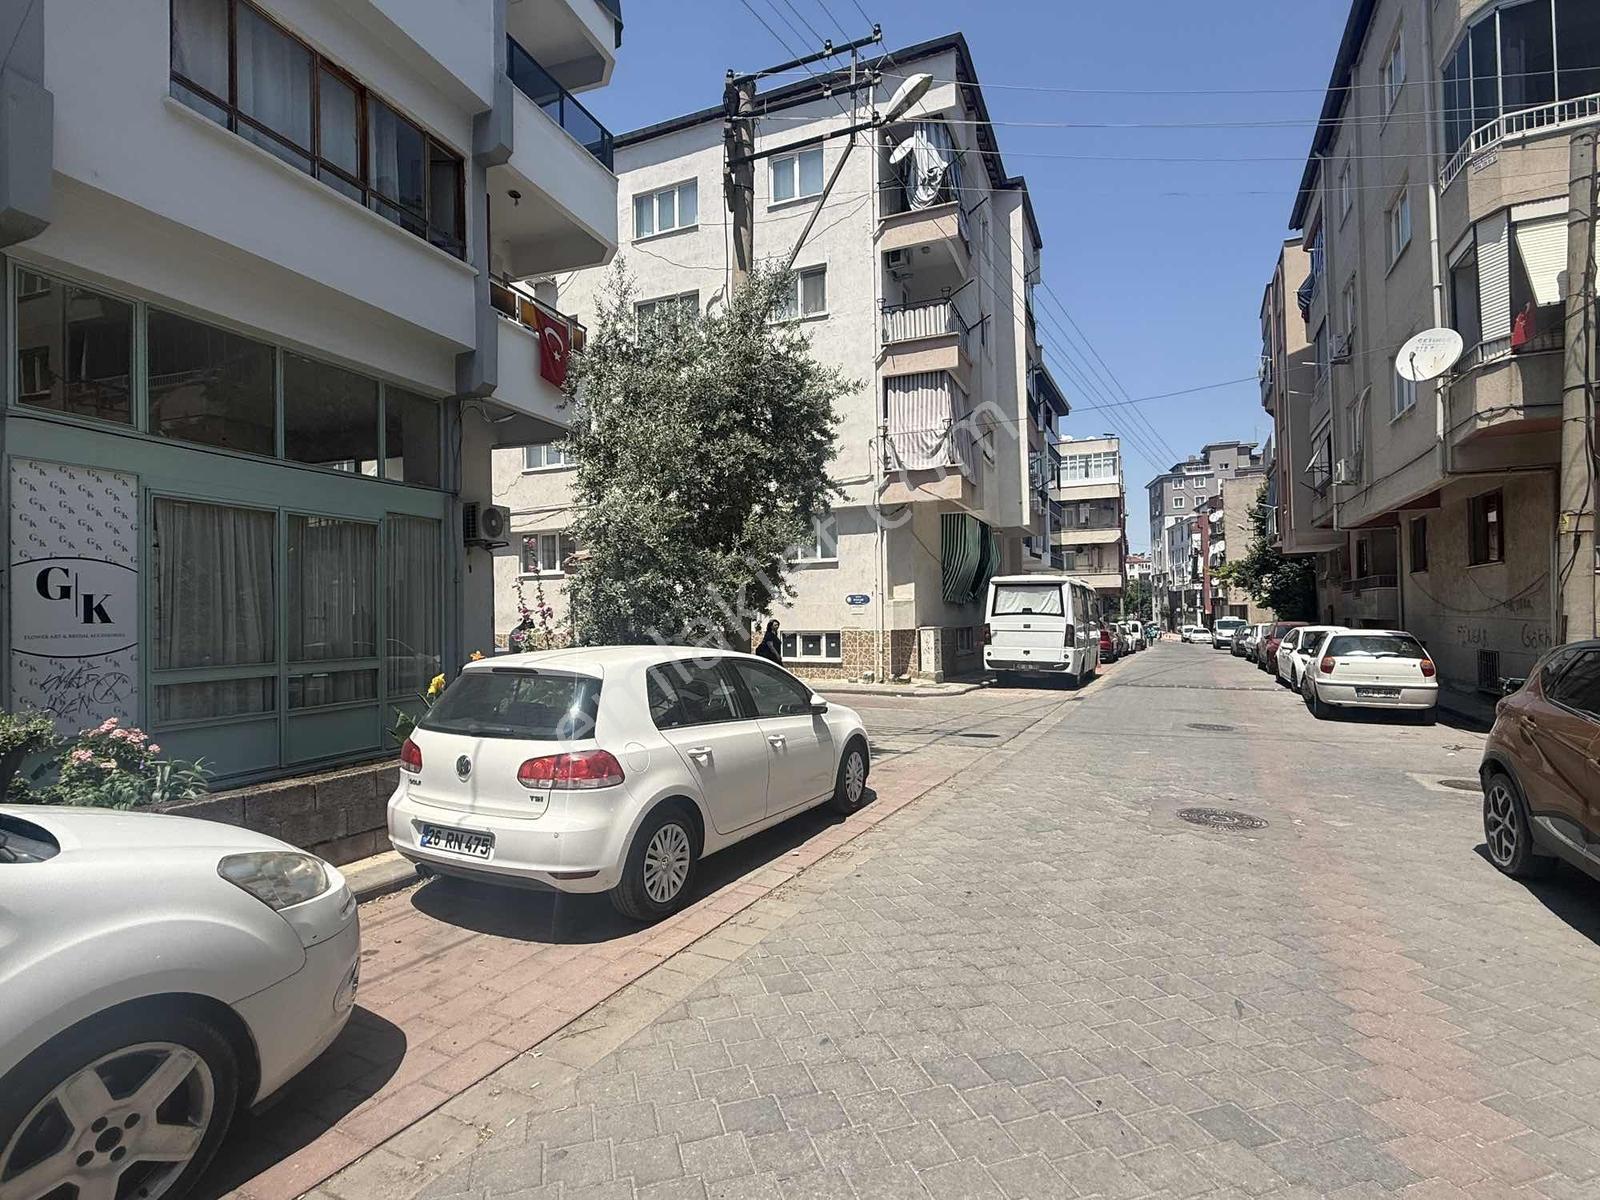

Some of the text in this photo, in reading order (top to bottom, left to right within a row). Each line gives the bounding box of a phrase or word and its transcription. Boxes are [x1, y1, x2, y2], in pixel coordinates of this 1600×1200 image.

[427, 828, 490, 855] 26 RN 475
